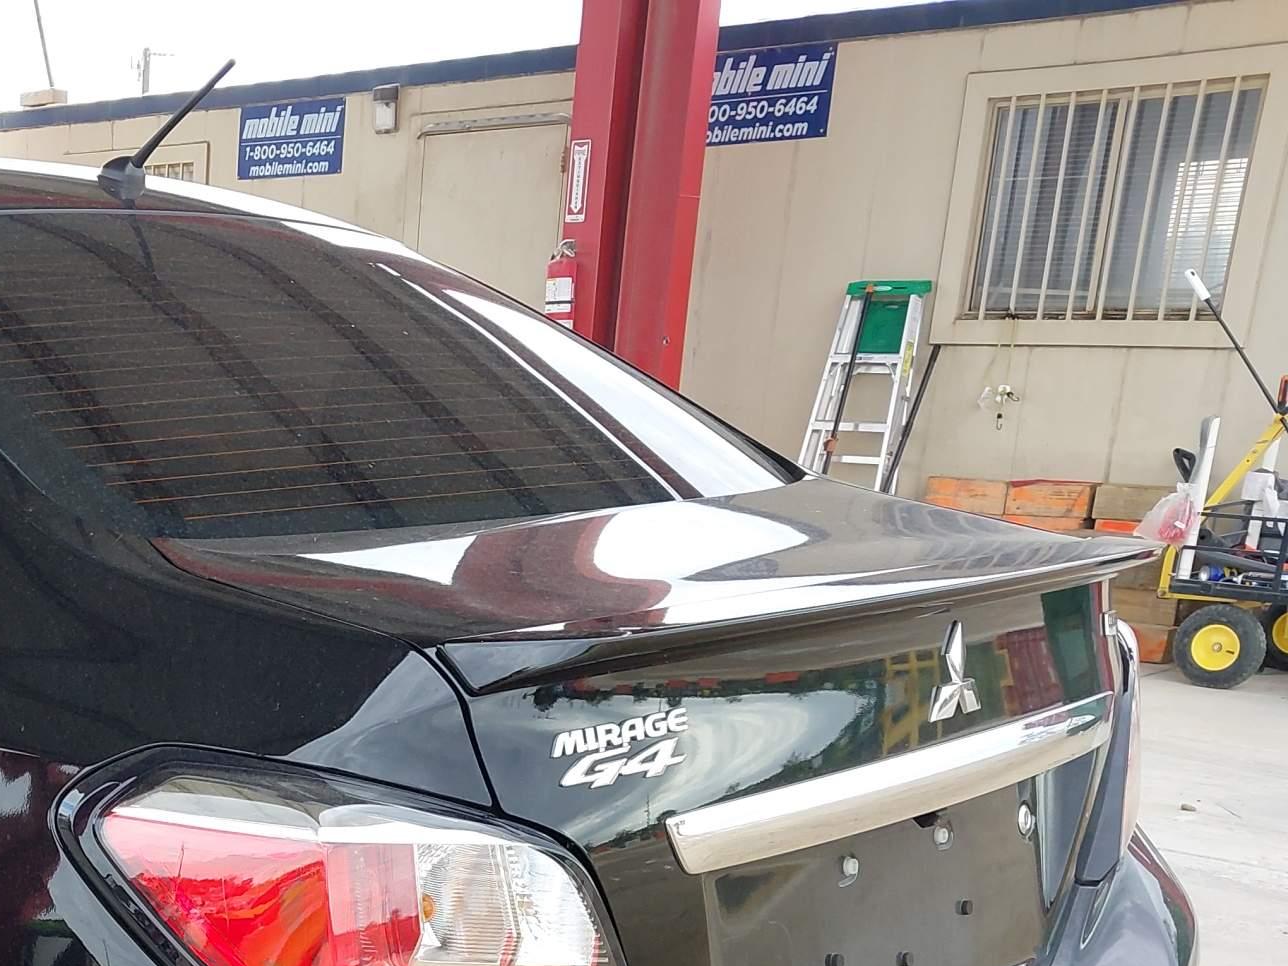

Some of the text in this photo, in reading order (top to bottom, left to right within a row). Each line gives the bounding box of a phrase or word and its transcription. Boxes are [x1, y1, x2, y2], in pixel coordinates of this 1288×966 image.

[766, 52, 830, 91] mini
[242, 105, 343, 140] mobile mini
[245, 140, 335, 161] 1-800-950-6464
[249, 160, 329, 177] mobilemini.com
[552, 707, 689, 758] MIRAGE
[559, 737, 688, 789] G4
